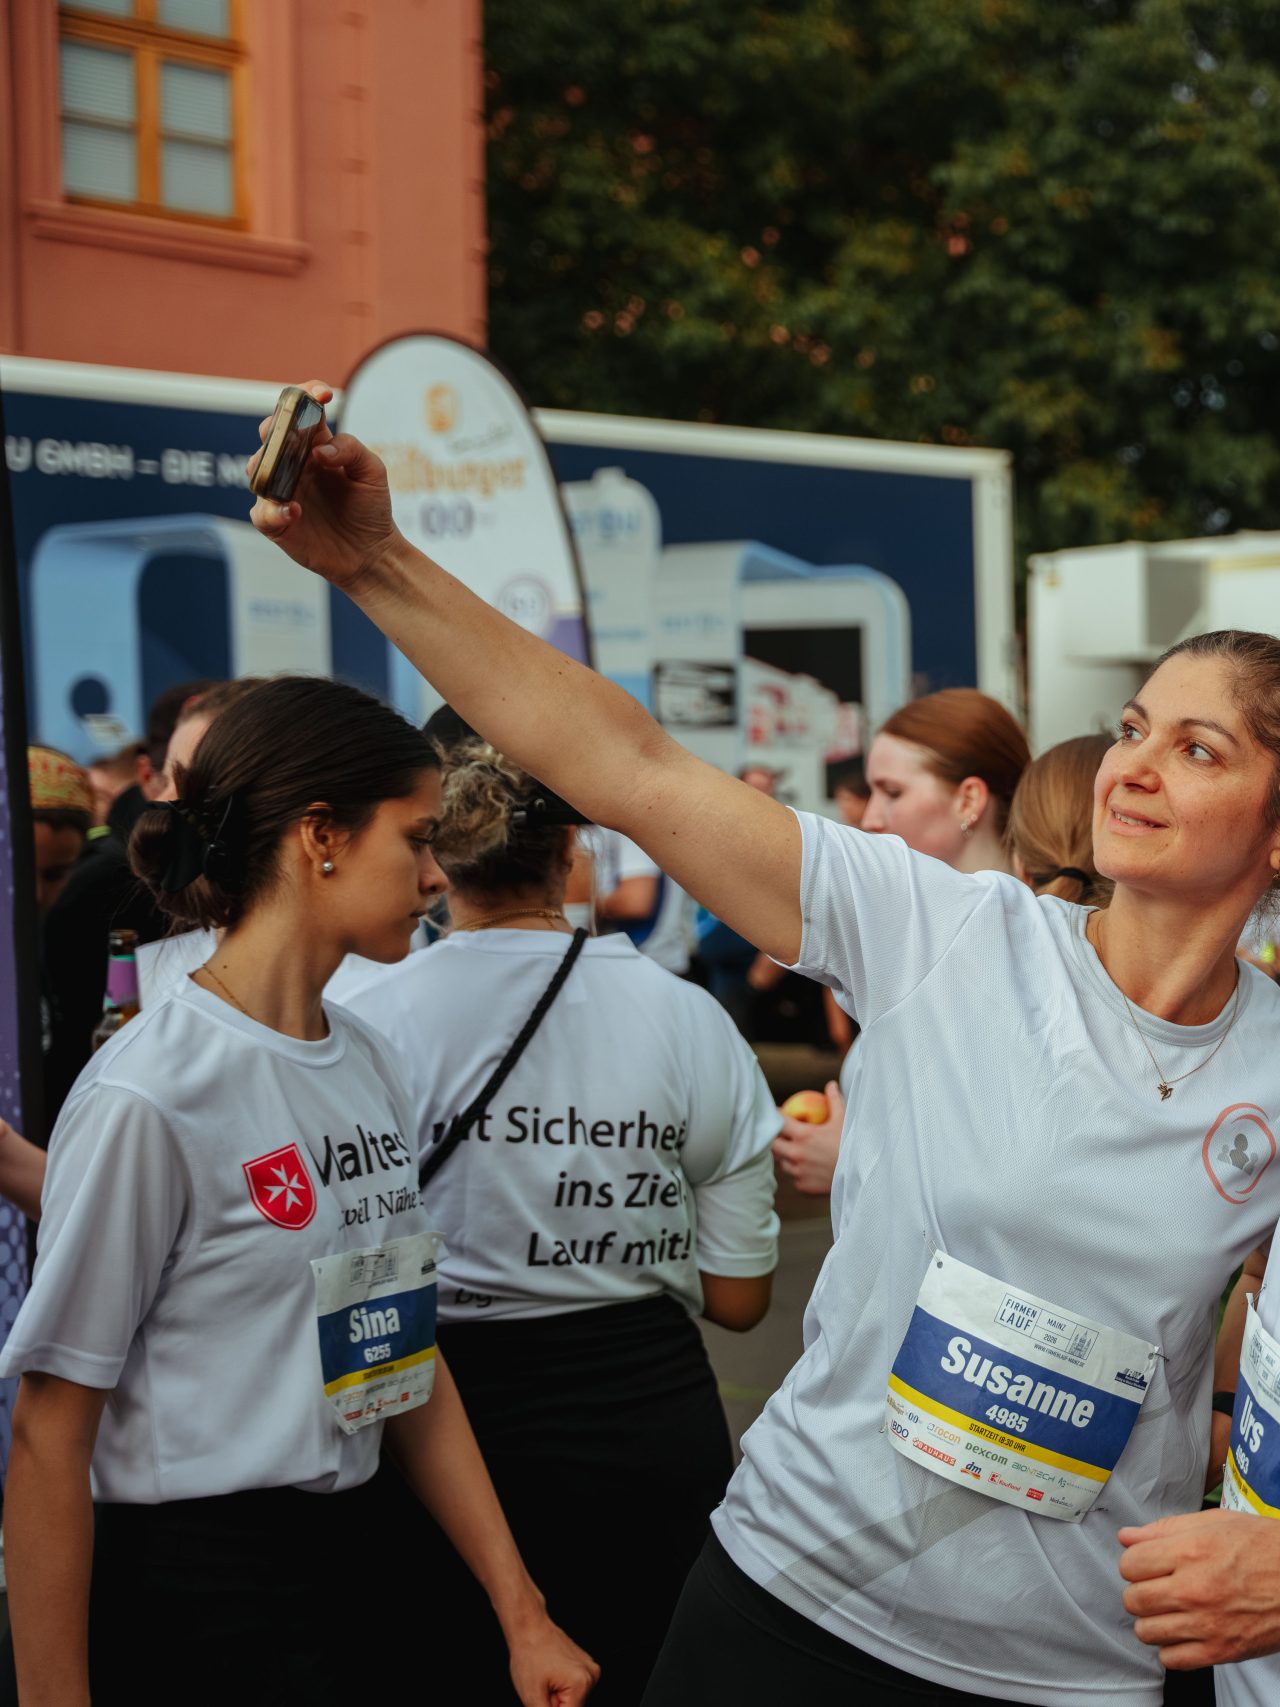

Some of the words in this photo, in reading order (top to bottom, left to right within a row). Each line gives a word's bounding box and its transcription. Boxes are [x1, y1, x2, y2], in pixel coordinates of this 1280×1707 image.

[505, 1106, 686, 1150] Sicherhei
[554, 1171, 614, 1208] ins
[527, 1231, 618, 1267] Lauf
[621, 1228, 691, 1266] mit!
[999, 1309, 1034, 1332] LAUF
[1005, 1298, 1038, 1319] FIRMEN
[349, 1306, 401, 1344] Sina
[1046, 1318, 1067, 1332] MAINZ
[363, 1343, 391, 1363] 6255
[940, 1336, 1095, 1428] Susanne
[892, 1419, 909, 1438] BDO
[985, 1404, 1030, 1433] 4985
[1239, 1394, 1264, 1453] Urs
[968, 1423, 999, 1442] STARTZEIT
[1013, 1440, 1027, 1453] UHR
[918, 1442, 957, 1466] BAUHAUS
[965, 1461, 982, 1475] dm
